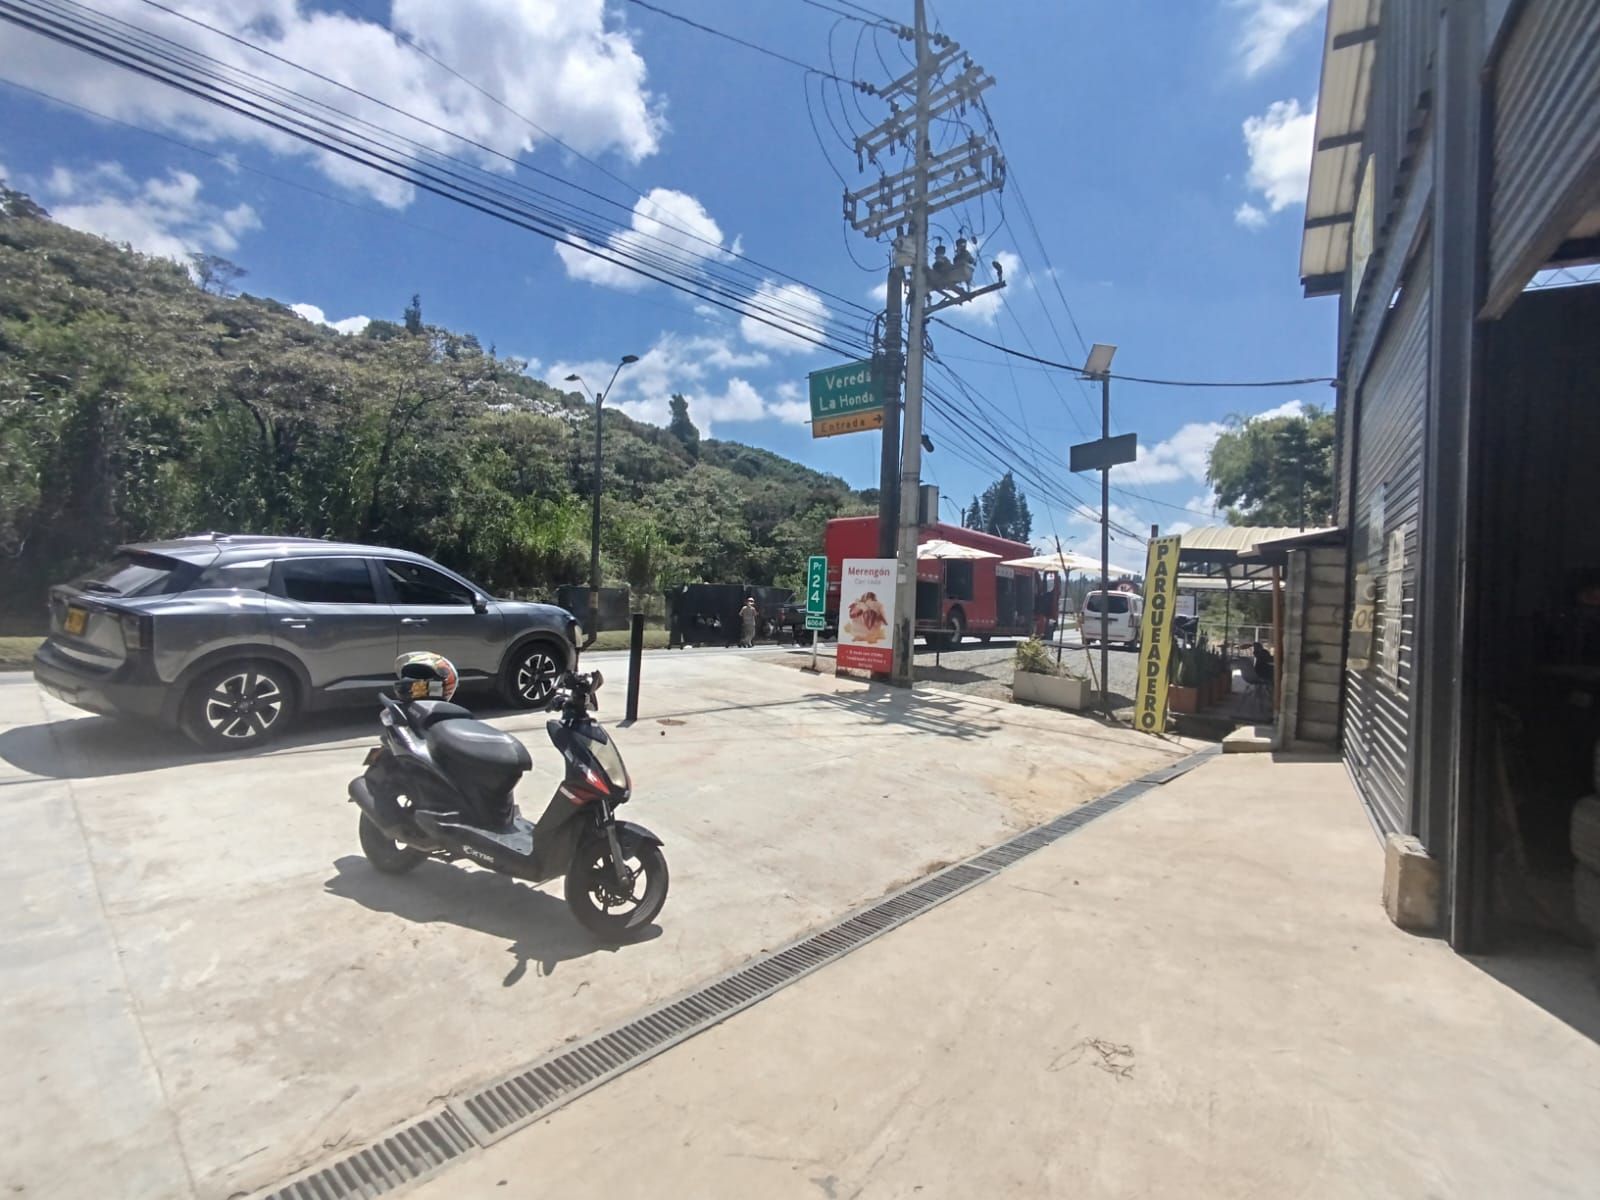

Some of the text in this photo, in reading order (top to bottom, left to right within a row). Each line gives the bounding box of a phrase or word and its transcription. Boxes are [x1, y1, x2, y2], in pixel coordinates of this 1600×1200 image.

[819, 391, 874, 411] La Honda
[822, 419, 865, 432] Entrada
[813, 561, 822, 571] Pr
[1141, 544, 1169, 729] PARQUEADERO
